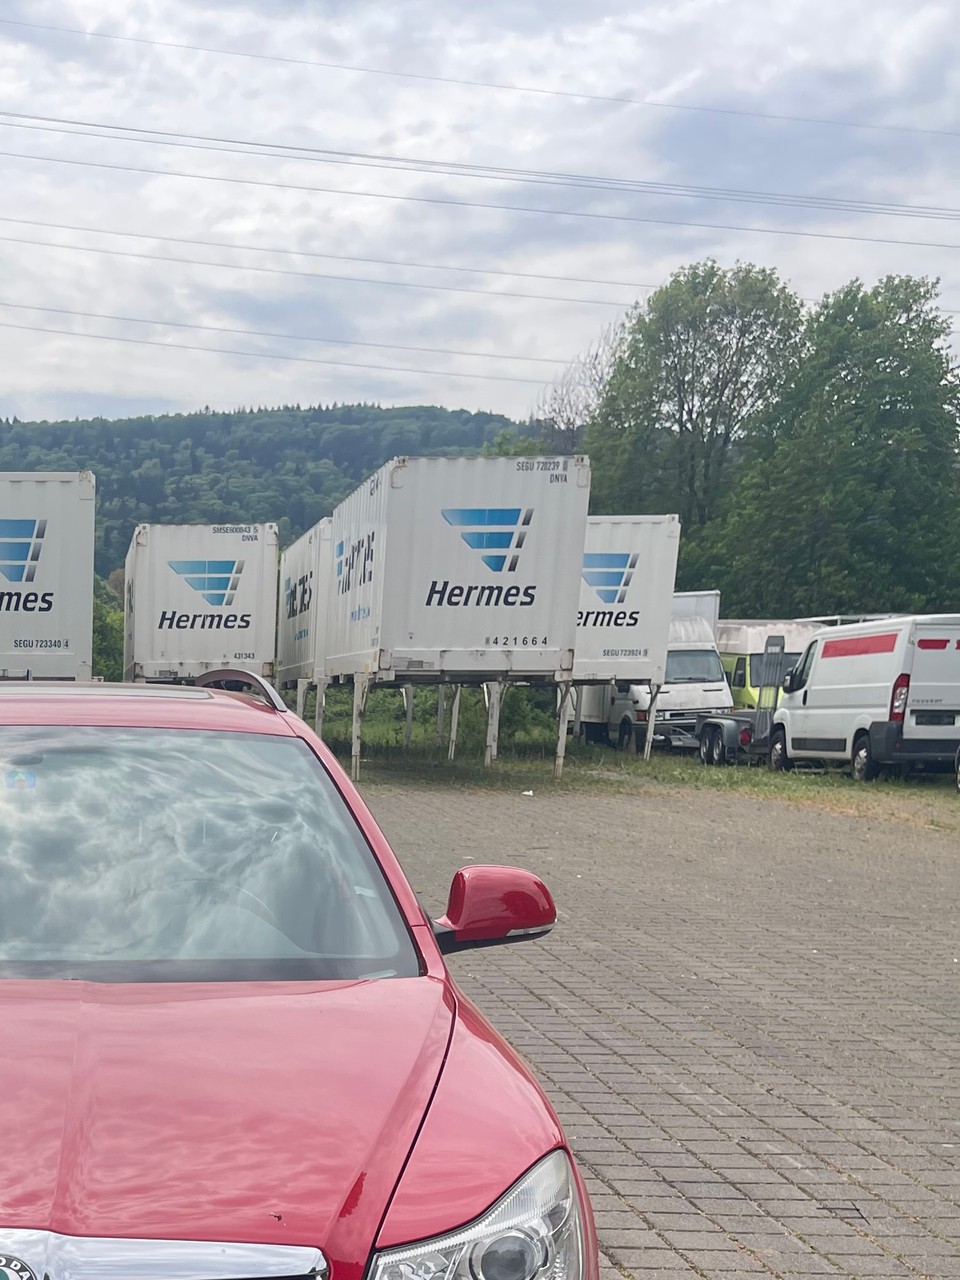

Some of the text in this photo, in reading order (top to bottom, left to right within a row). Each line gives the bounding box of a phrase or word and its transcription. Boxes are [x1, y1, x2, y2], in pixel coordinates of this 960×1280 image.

[425, 581, 536, 607] Hermes
[158, 611, 251, 629] Hermes
[576, 611, 640, 627] ermes
[13, 639, 34, 648] SEGU
[35, 639, 61, 648] 723340
[492, 636, 548, 646] 421664
